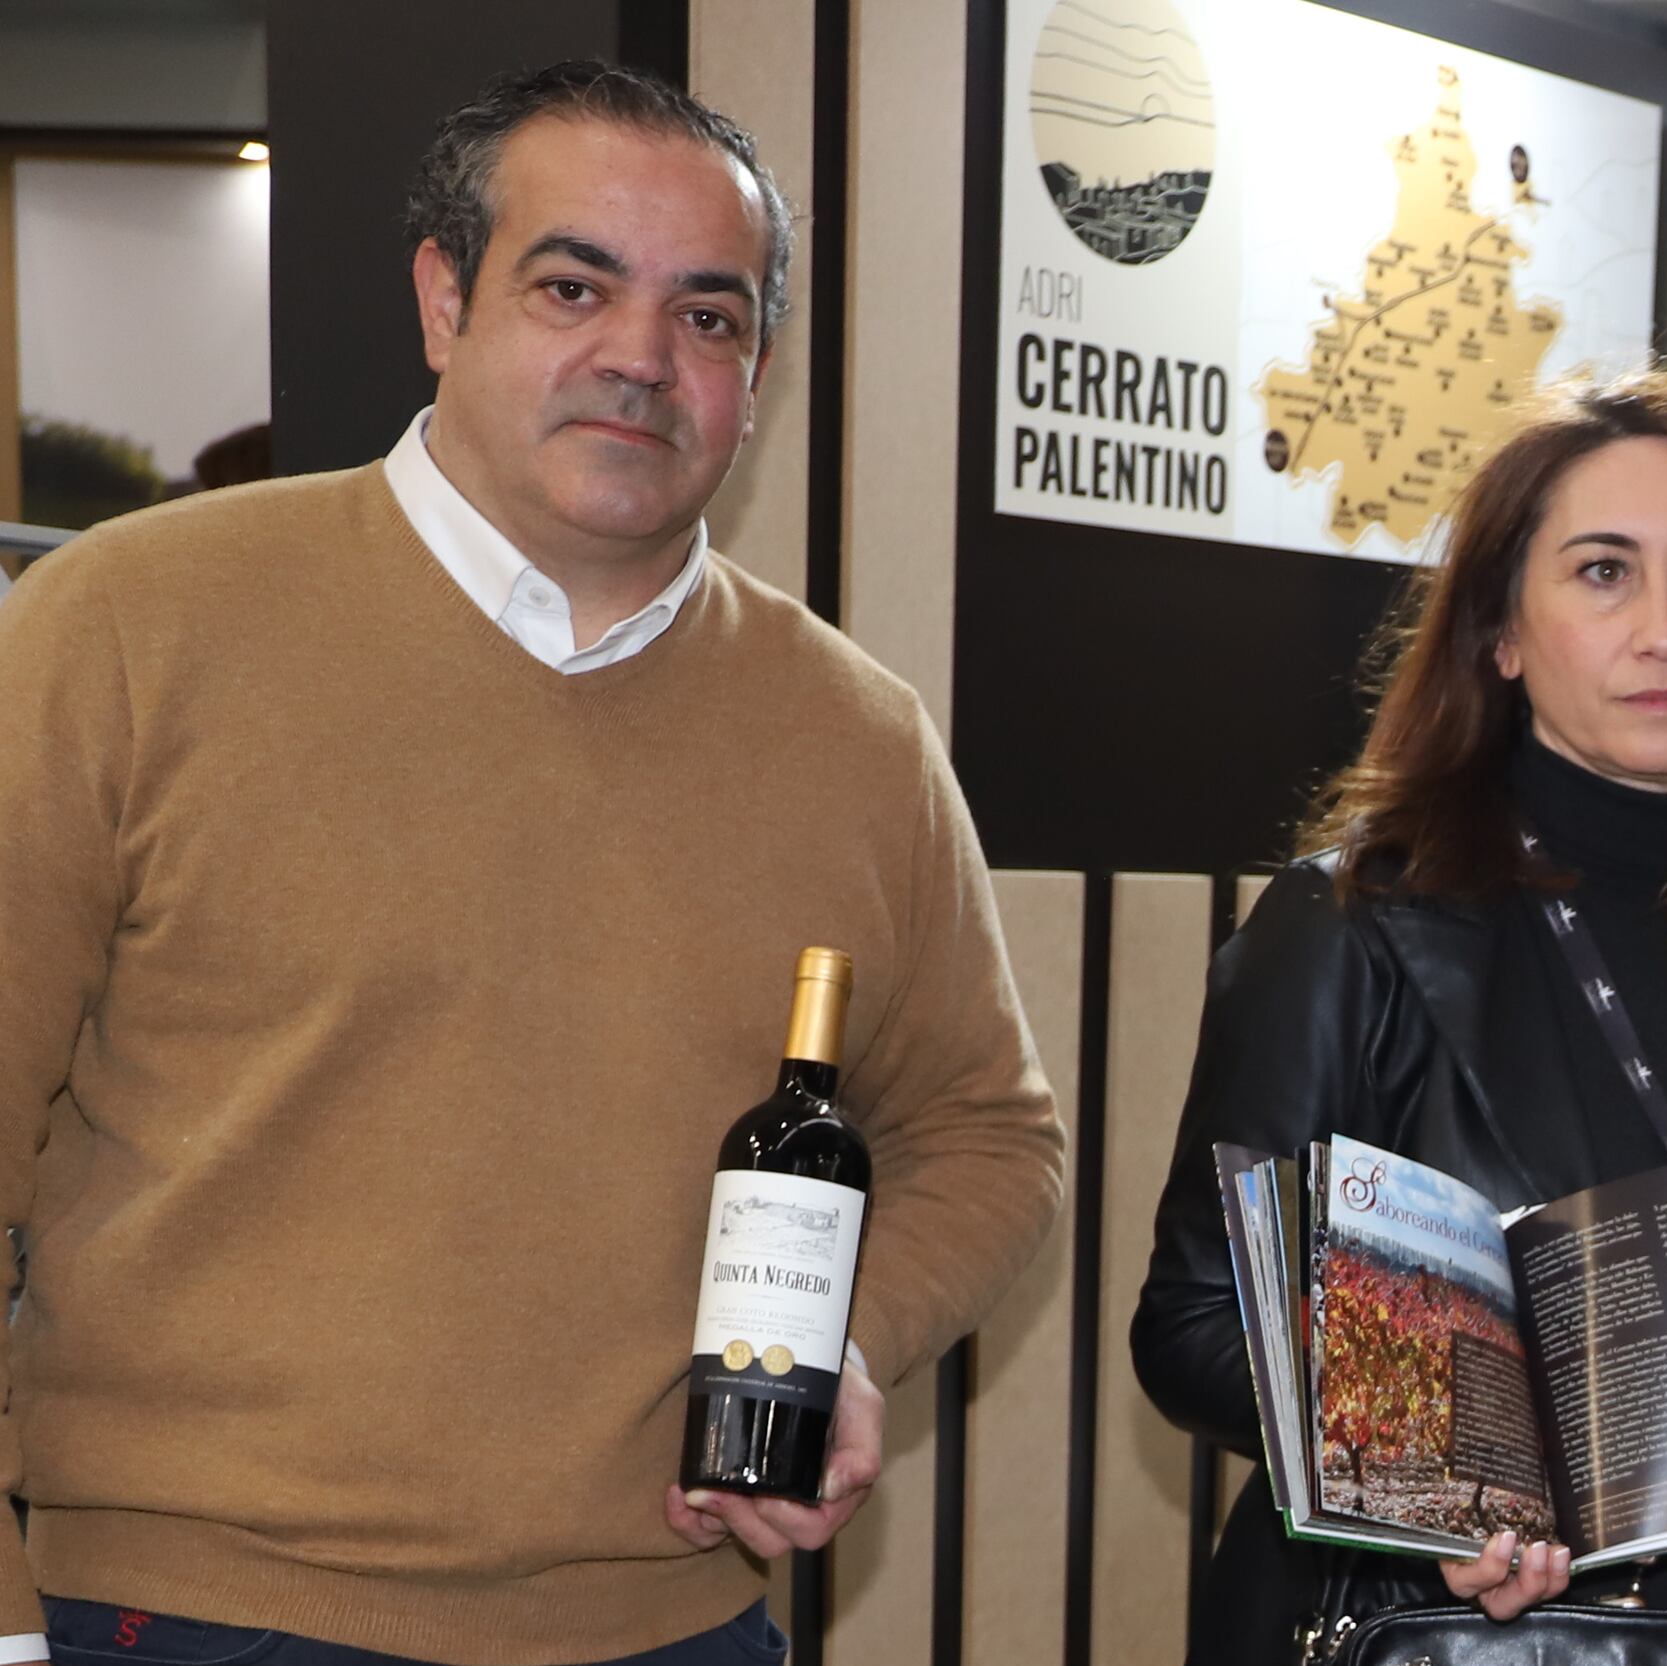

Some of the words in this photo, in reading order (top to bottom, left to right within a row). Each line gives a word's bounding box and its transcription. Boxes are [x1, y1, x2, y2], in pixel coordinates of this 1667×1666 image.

[1017, 265, 1083, 323] ADRI
[1017, 333, 1228, 436] CERRATO
[1013, 426, 1228, 515] PALENTINO
[1340, 1156, 1456, 1242] Saboreando
[713, 1260, 759, 1284] QUINTA
[764, 1264, 831, 1296] NEGREDO
